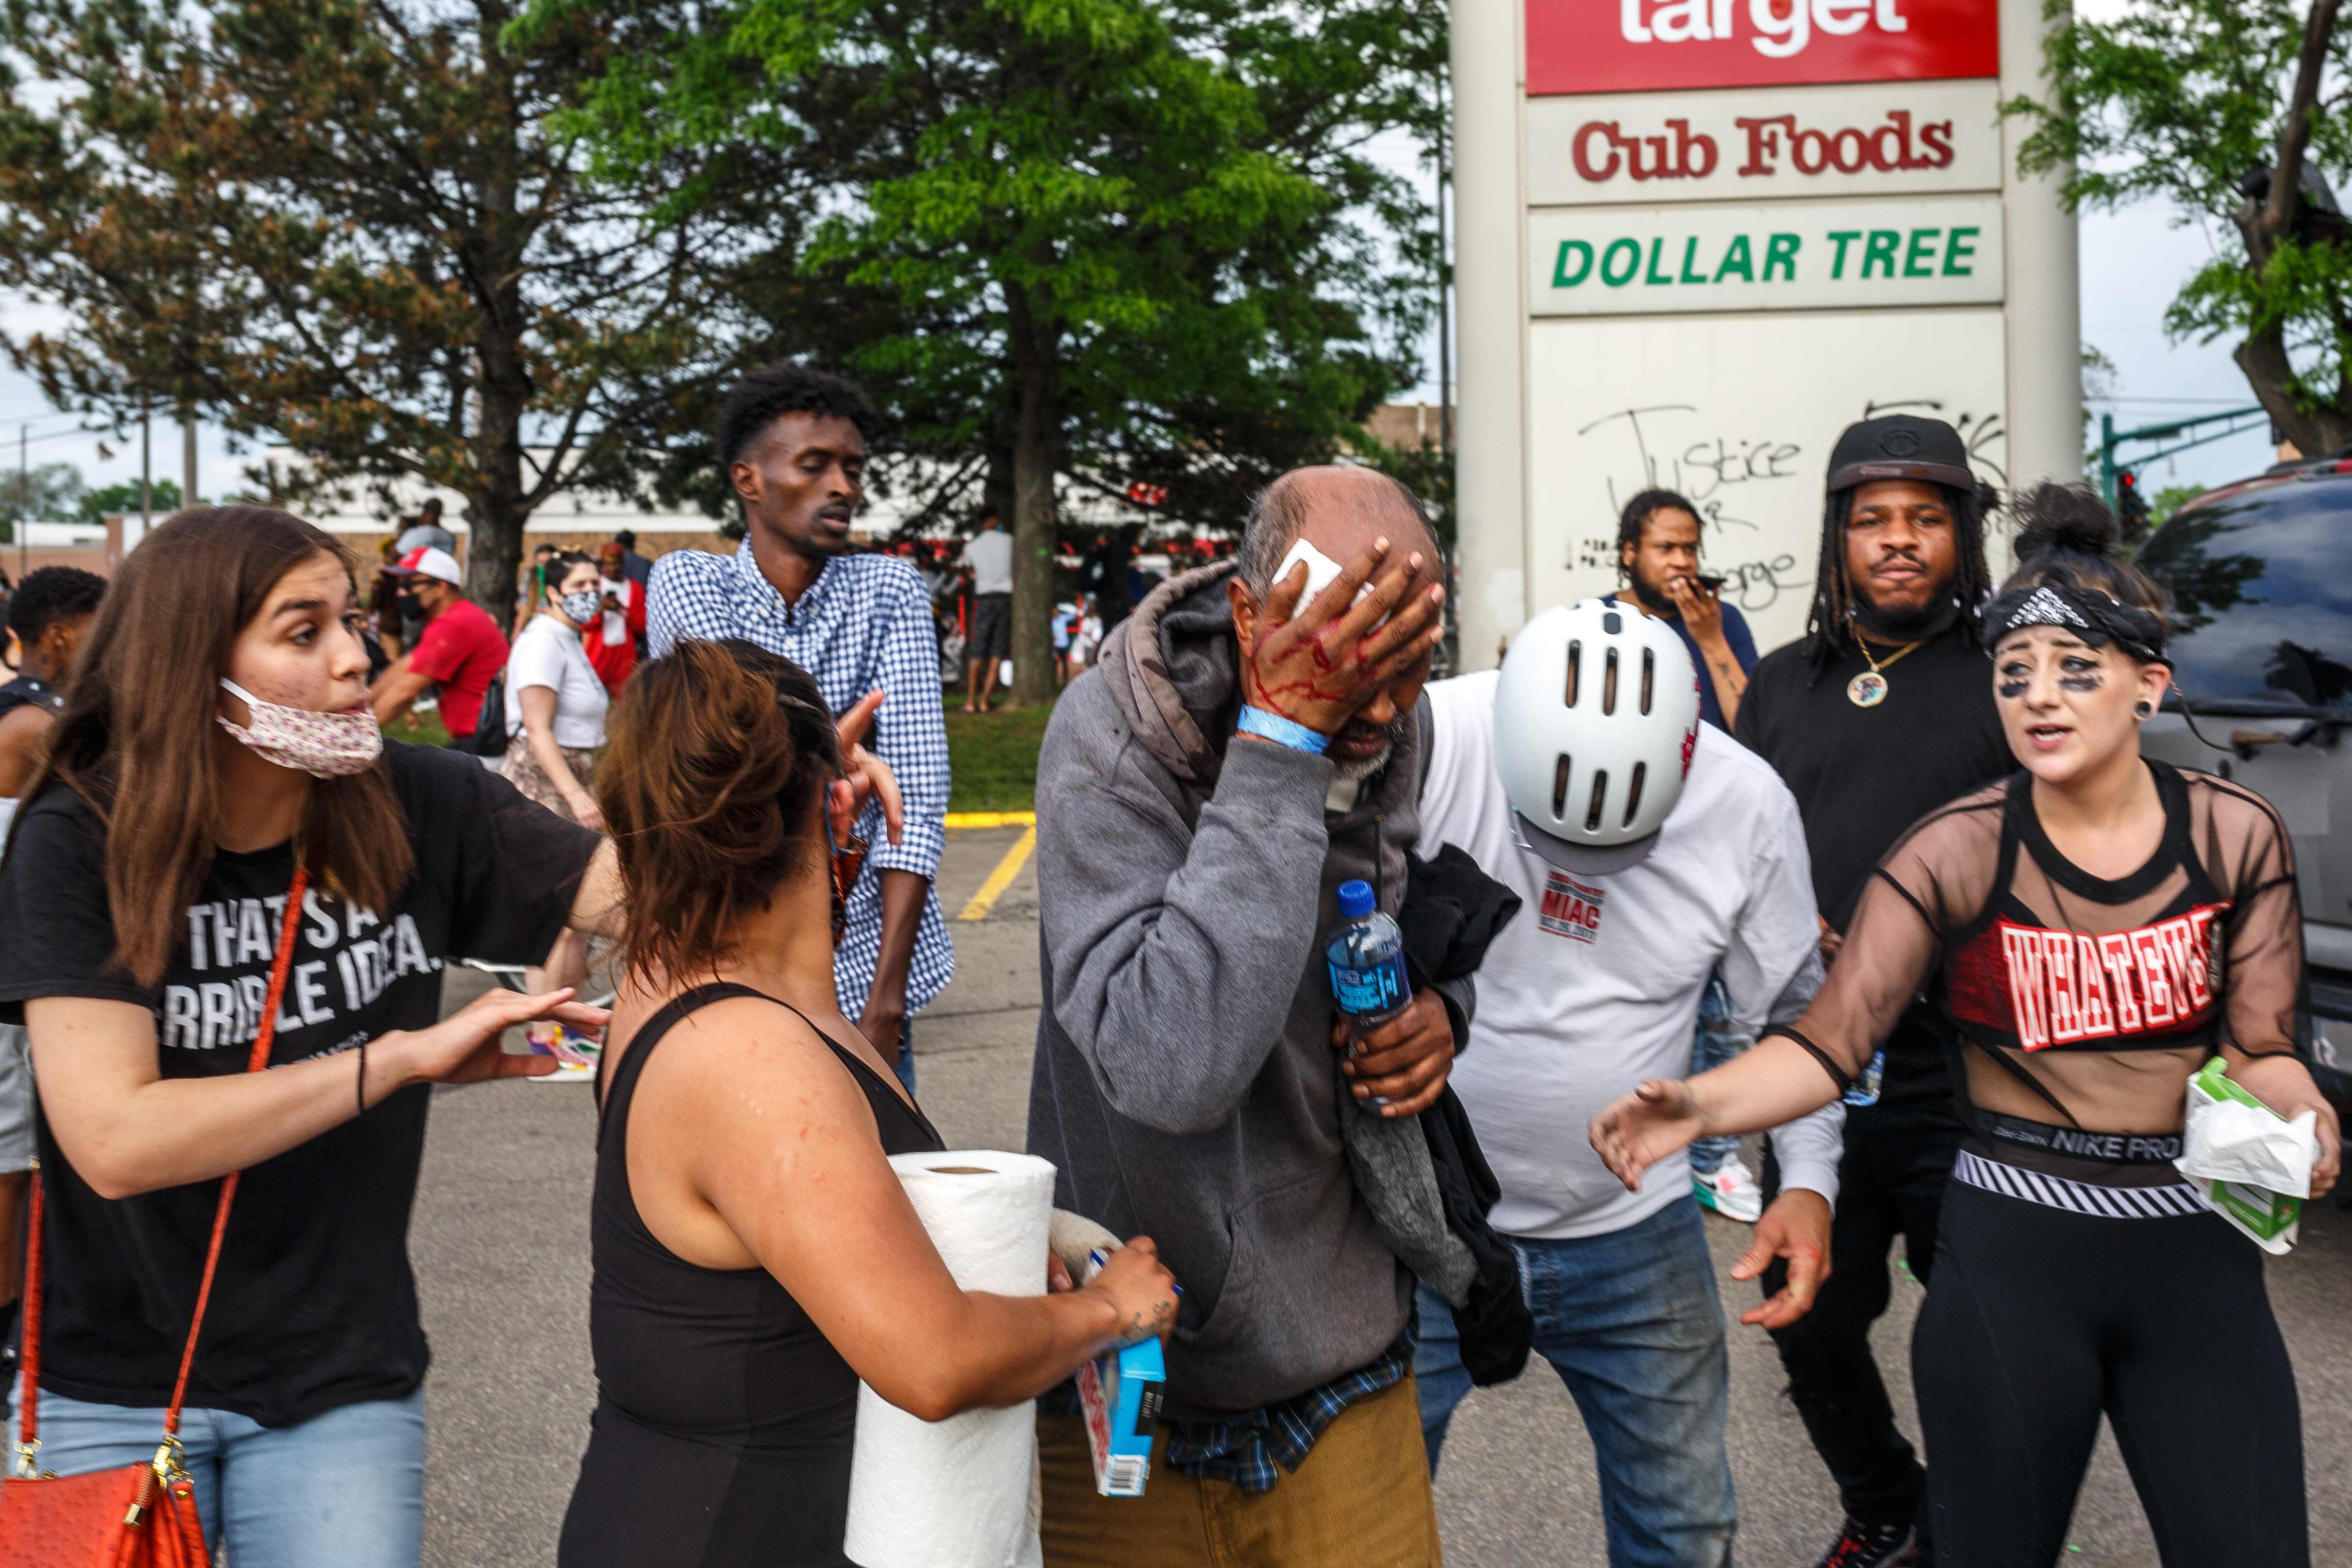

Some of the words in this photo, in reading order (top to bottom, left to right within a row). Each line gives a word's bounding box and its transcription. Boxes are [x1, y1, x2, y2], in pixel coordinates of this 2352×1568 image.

[1621, 0, 1908, 58] target
[1572, 119, 1719, 182] Cub
[1734, 110, 1955, 177] Foods
[1552, 232, 1802, 288] DOLLAR
[1826, 226, 1980, 280] TREE
[185, 887, 339, 971] THATS
[156, 959, 335, 1050] RRIBLE
[2051, 1129, 2124, 1159] NIKE
[2126, 1137, 2181, 1160] PRO
